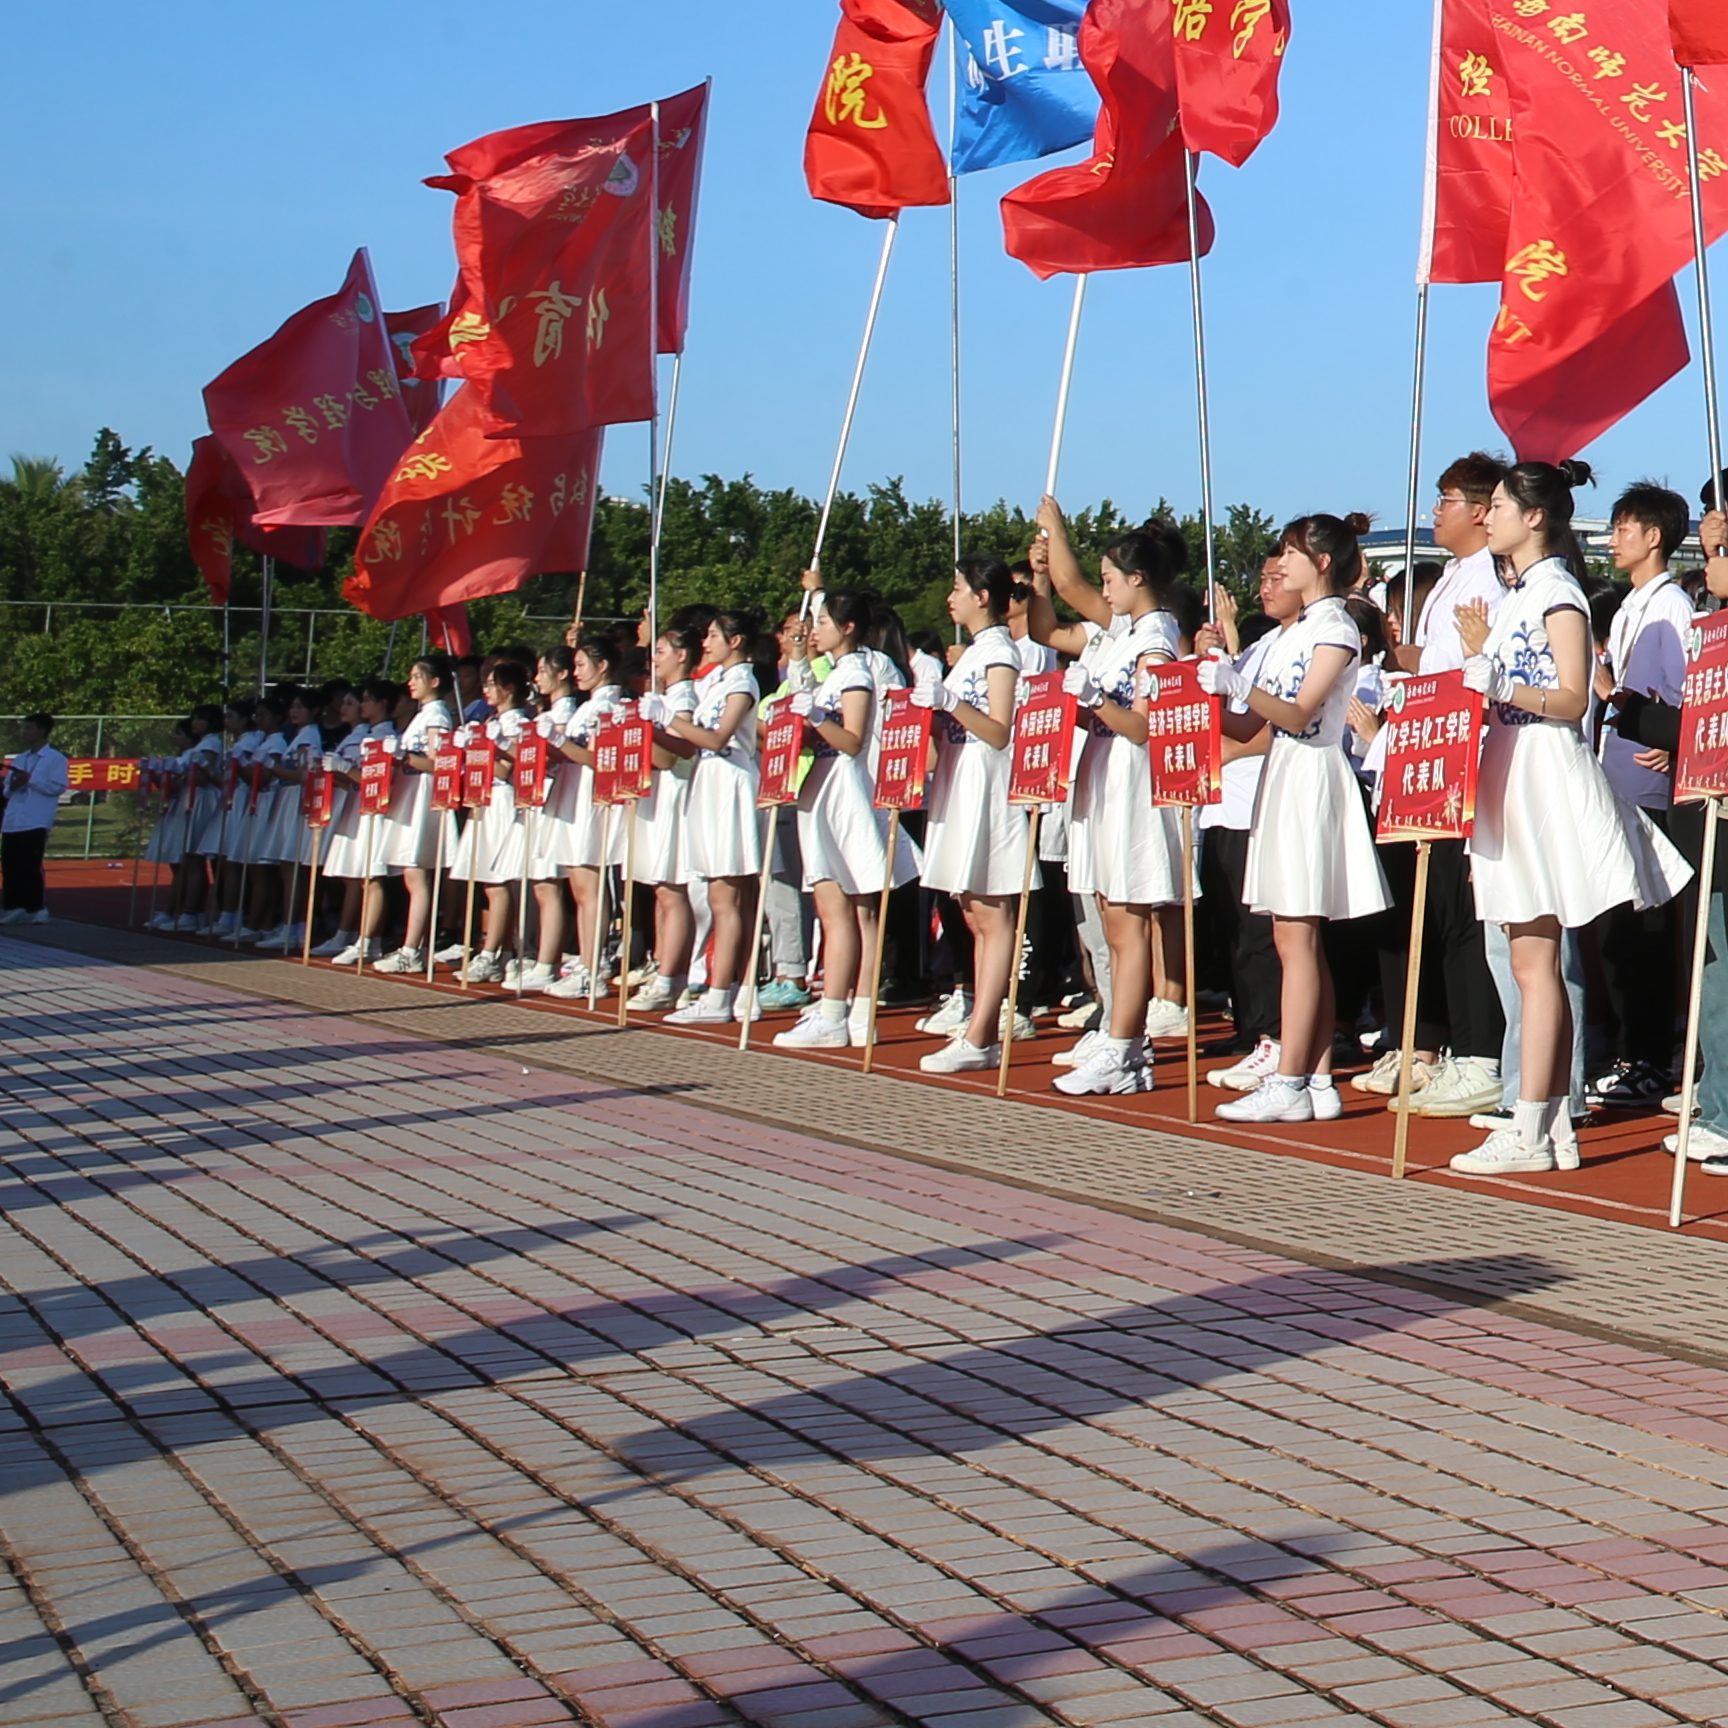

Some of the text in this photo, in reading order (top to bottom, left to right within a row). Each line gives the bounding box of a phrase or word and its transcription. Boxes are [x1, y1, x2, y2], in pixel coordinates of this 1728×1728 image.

[824, 52, 888, 130] 院
[1491, 13, 1691, 199] HAINAN NORMAL UNIVERSITY
[1020, 706, 1062, 738] 外国语学院
[1148, 701, 1210, 737] 经济与管理学院
[1387, 709, 1471, 756] 化学与化工学院
[1023, 742, 1050, 771] 代表队
[1164, 742, 1196, 774] 代表队
[1402, 757, 1445, 796] 代表队
